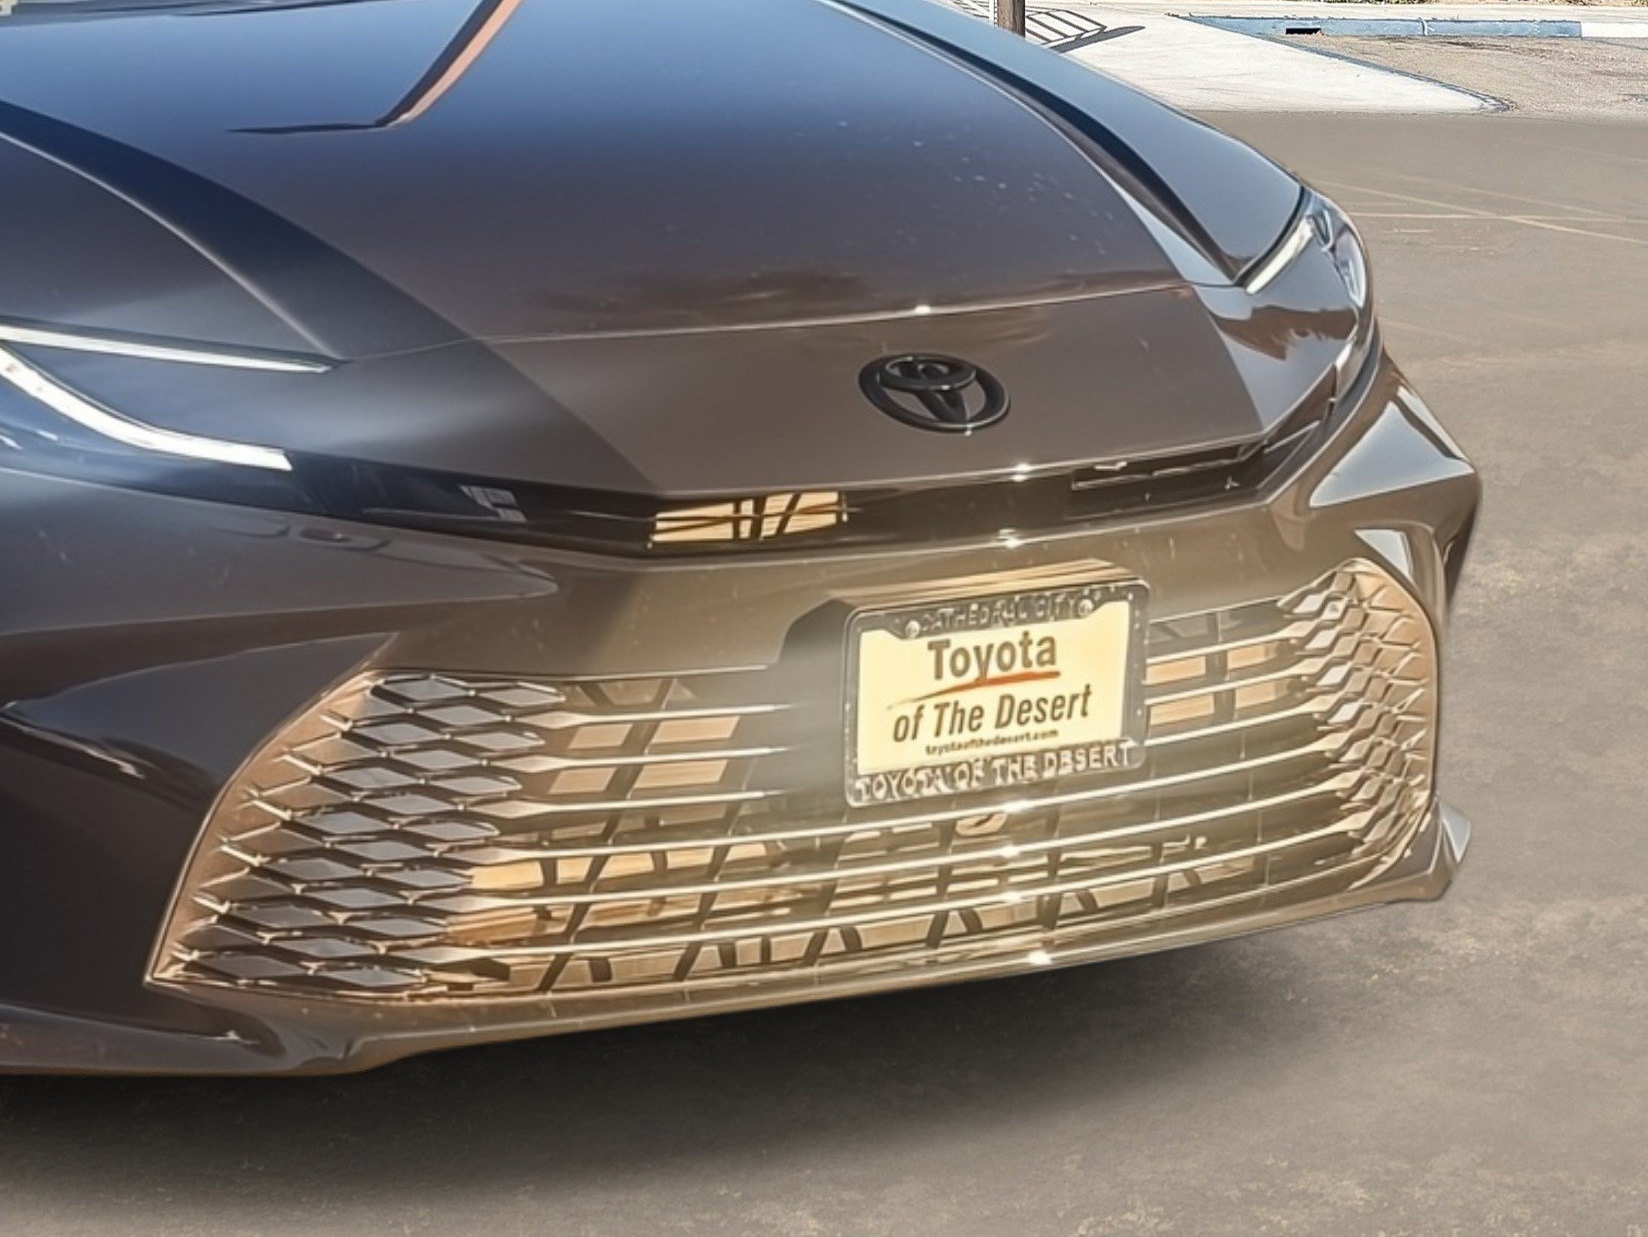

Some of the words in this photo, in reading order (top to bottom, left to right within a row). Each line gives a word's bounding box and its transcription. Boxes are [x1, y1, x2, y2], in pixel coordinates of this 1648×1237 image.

[928, 631, 1058, 681] Toyota
[892, 704, 926, 743] of
[933, 700, 984, 738] The
[995, 684, 1093, 730] Desert
[855, 766, 949, 802] TOYOTA
[954, 759, 985, 788] OF
[991, 752, 1037, 784] THE
[1043, 741, 1131, 778] DESERT
